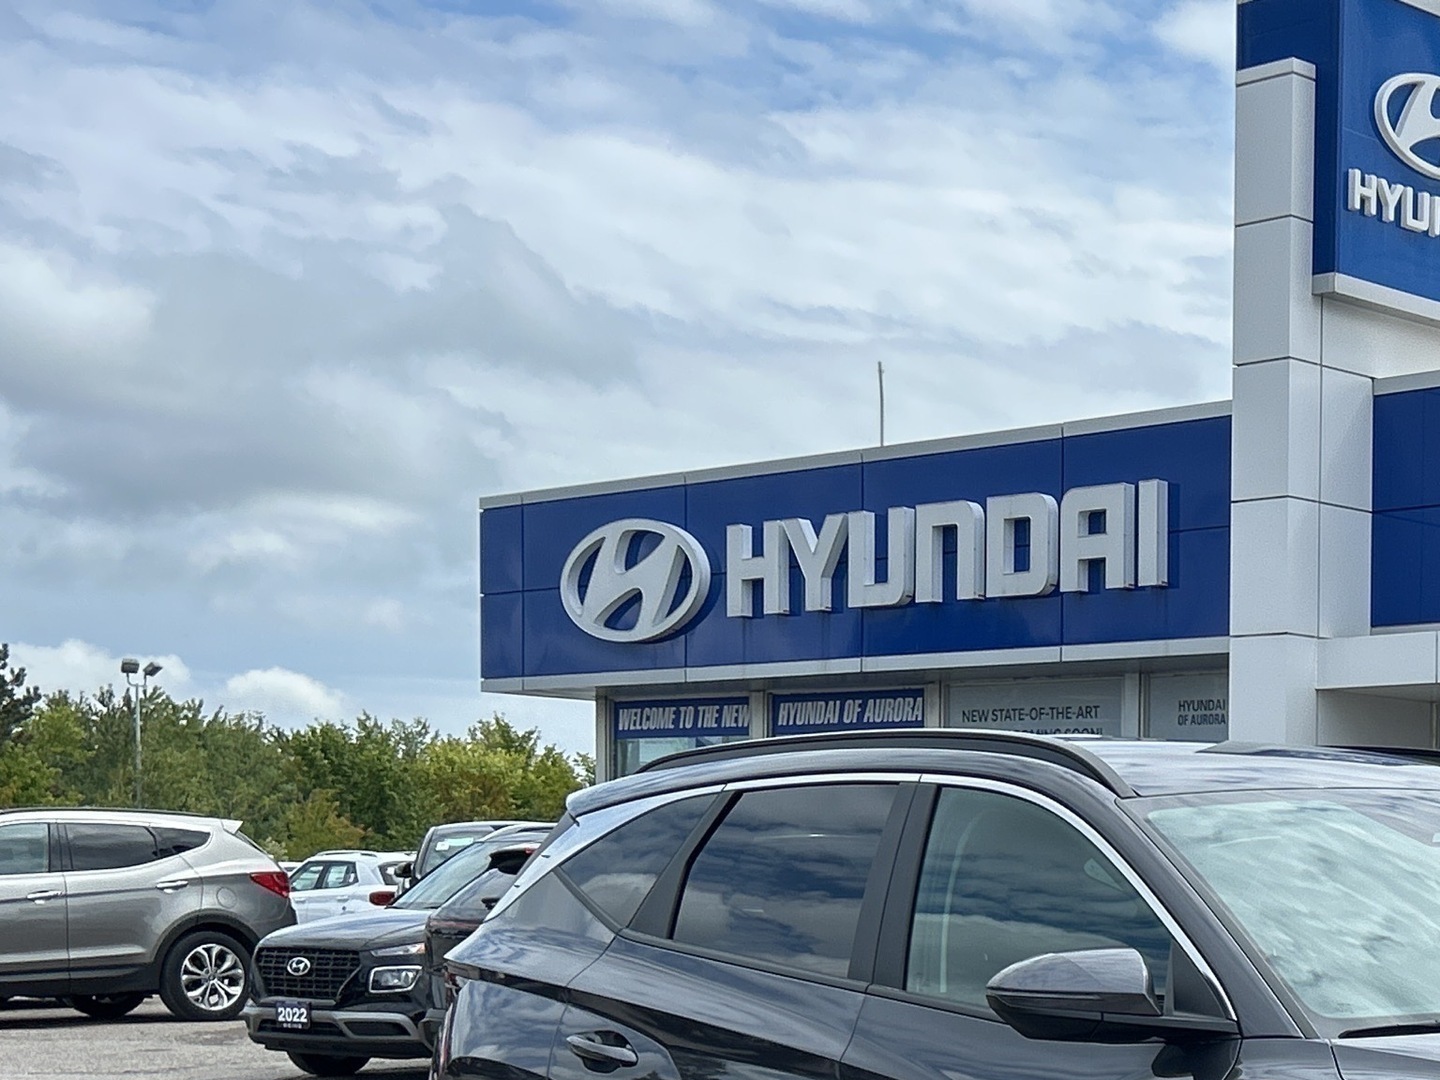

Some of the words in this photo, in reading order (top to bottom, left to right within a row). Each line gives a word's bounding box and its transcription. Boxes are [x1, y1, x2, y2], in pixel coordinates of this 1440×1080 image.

[725, 477, 1169, 618] HYUNDAI
[777, 700, 841, 726] HYUNDAI
[843, 699, 862, 724] OF
[863, 697, 923, 723] AURORA
[962, 709, 991, 723] NEW
[991, 705, 1101, 722] STATE-OF-THE-ART
[1178, 699, 1226, 712] HYUNDAI
[618, 706, 677, 731] WELCOME
[679, 705, 695, 729] TO
[697, 705, 720, 728] THE
[721, 704, 750, 728] NEW
[1177, 714, 1189, 726] OF
[1190, 713, 1226, 726] AURORA
[277, 1007, 308, 1022] 2022
